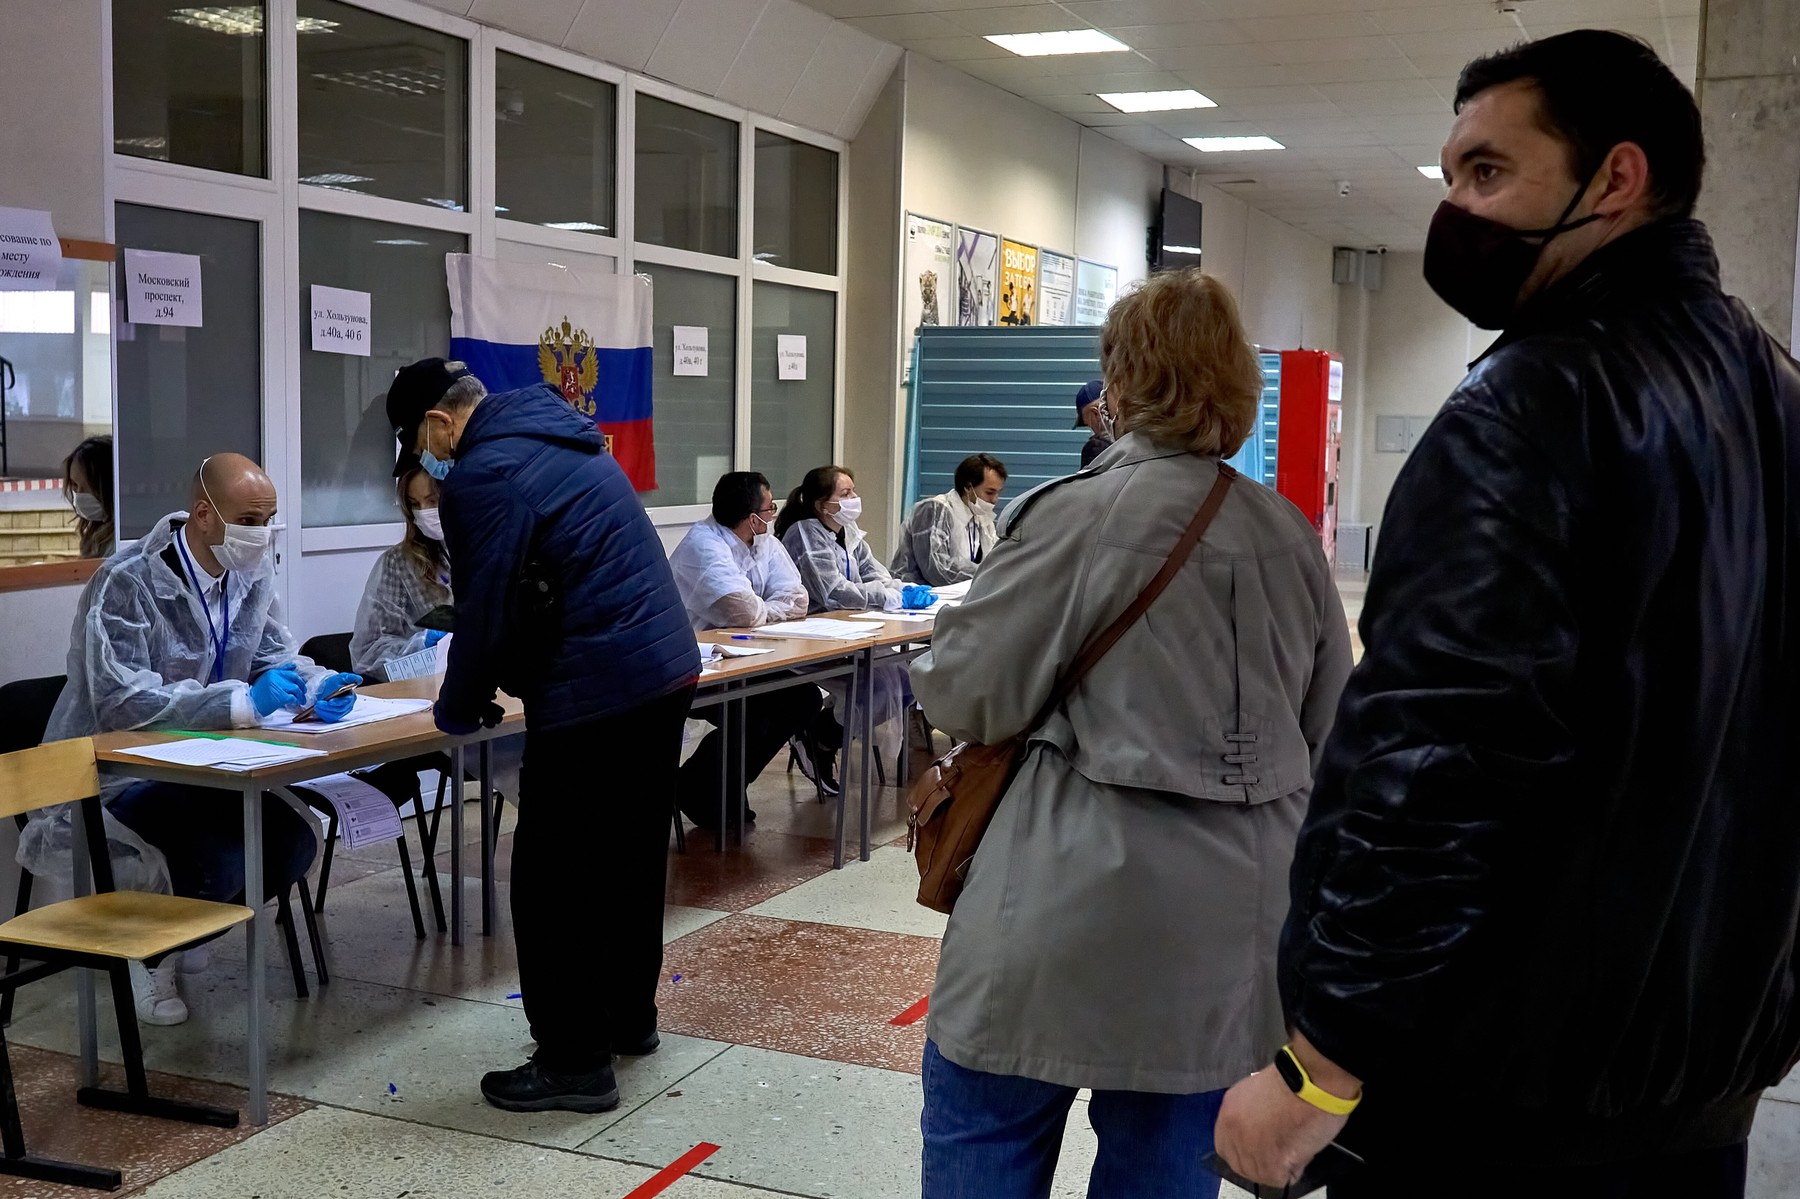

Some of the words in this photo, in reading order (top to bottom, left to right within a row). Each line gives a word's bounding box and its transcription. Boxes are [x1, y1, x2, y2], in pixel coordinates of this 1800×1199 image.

[39, 237, 52, 247] по
[1, 252, 30, 265] месту
[1005, 248, 1035, 273] ВЫБОР
[138, 272, 190, 288] Московский
[144, 291, 185, 305] проспект,
[154, 306, 174, 319] д.94
[313, 309, 324, 320] ул.
[345, 329, 355, 341] 40
